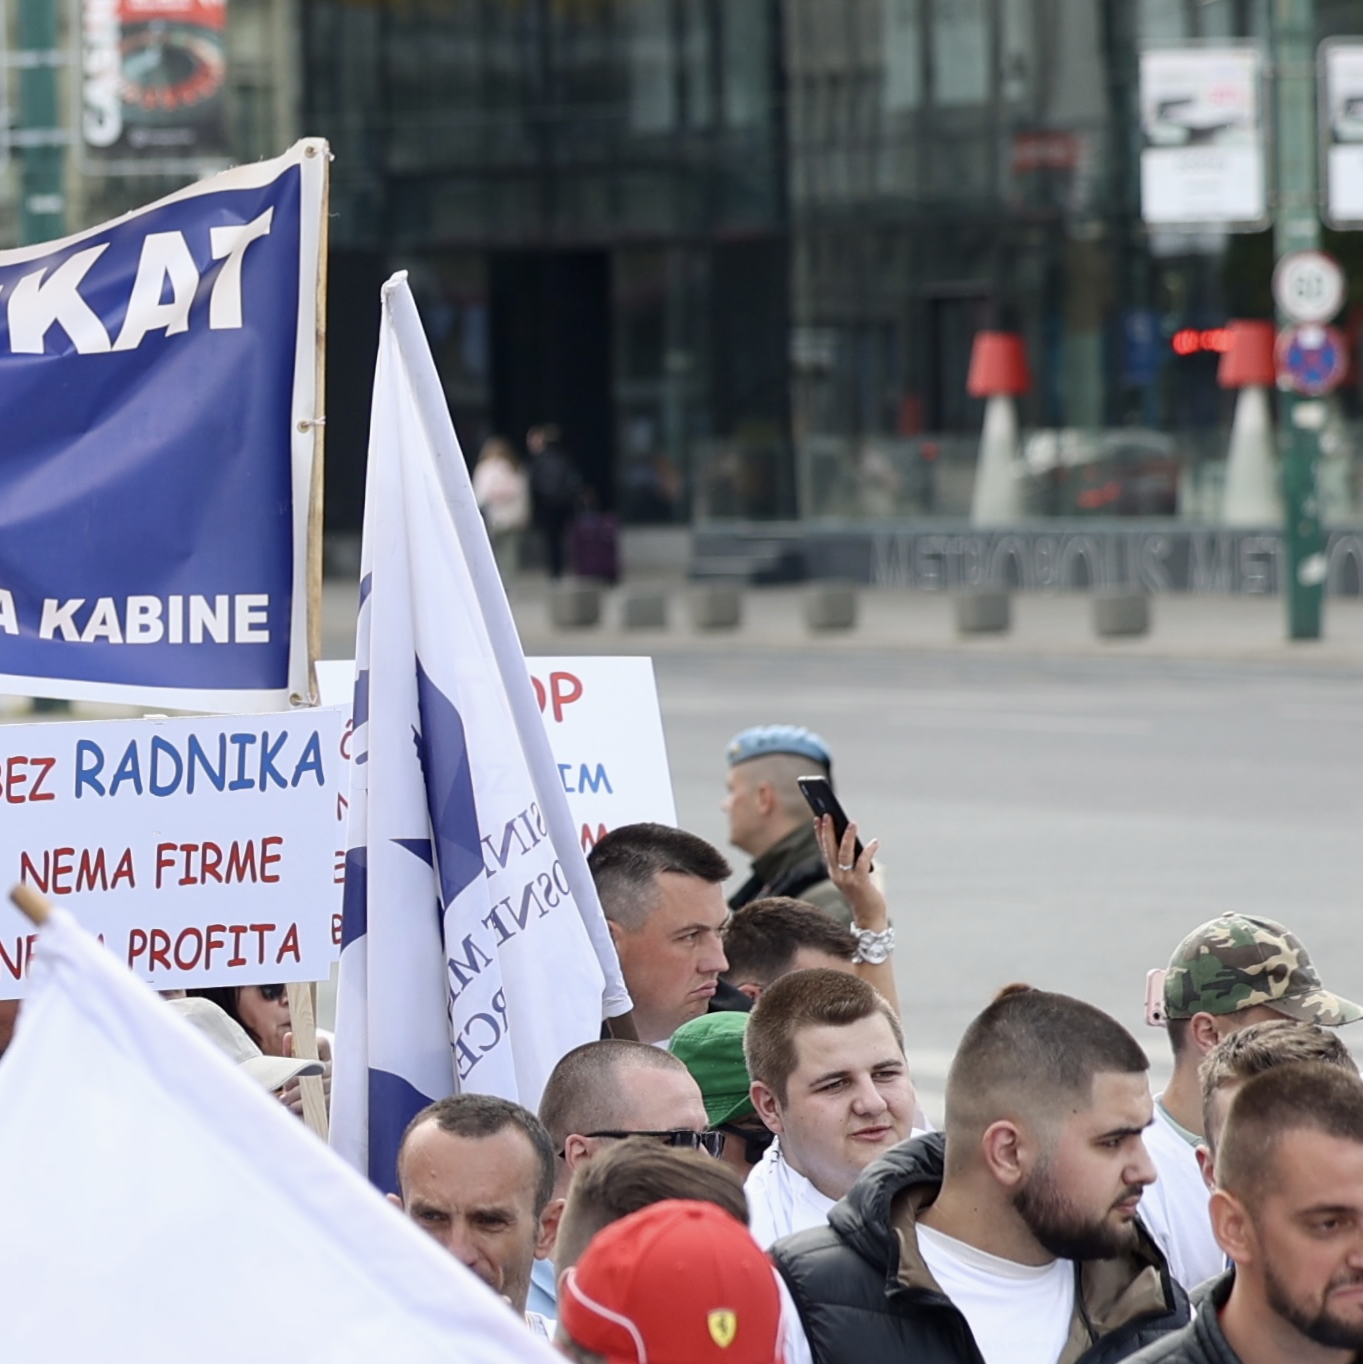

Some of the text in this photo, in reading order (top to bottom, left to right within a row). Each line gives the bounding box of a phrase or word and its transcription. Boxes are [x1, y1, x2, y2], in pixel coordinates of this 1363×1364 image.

[1190, 535, 1363, 597] METO
[39, 592, 270, 645] KABINE
[74, 729, 325, 799] RADNIKA
[20, 835, 284, 895] NEMA FIRME
[128, 922, 301, 972] PROFITA
